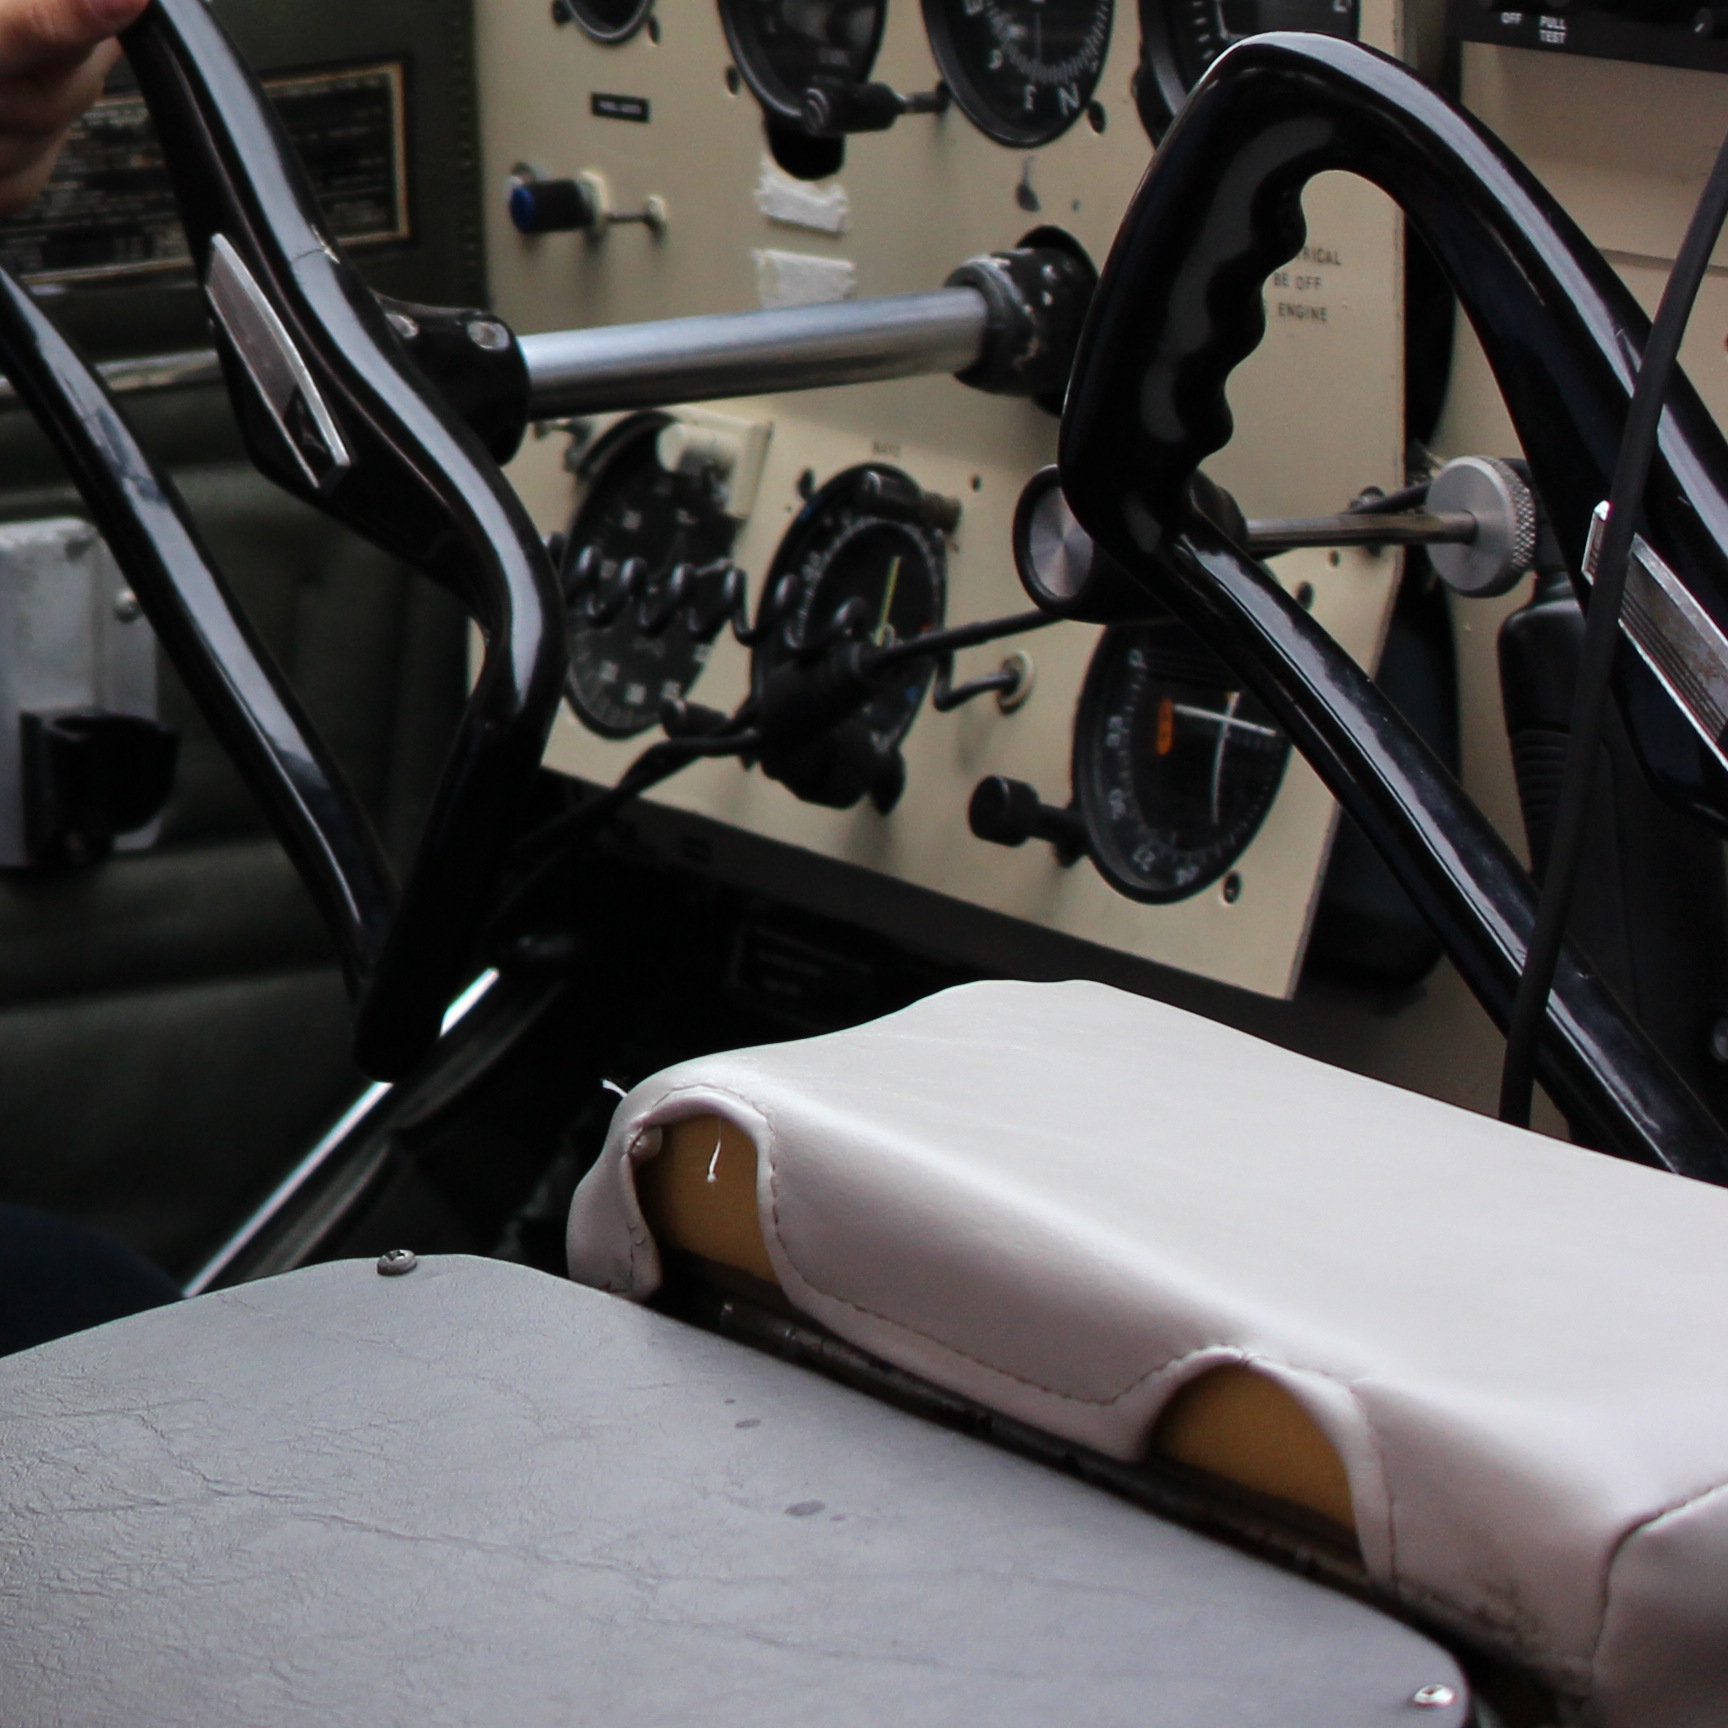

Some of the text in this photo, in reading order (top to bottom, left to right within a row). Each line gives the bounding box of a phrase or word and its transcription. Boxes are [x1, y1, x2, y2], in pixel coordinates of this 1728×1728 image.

[1501, 11, 1523, 25] OFF
[1539, 15, 1567, 31] PULL
[1539, 29, 1567, 44] TEST
[1058, 81, 1081, 116] N
[1298, 246, 1341, 266] RICAL
[1273, 272, 1321, 290] BE OFF
[1278, 302, 1328, 321] ENGINE
